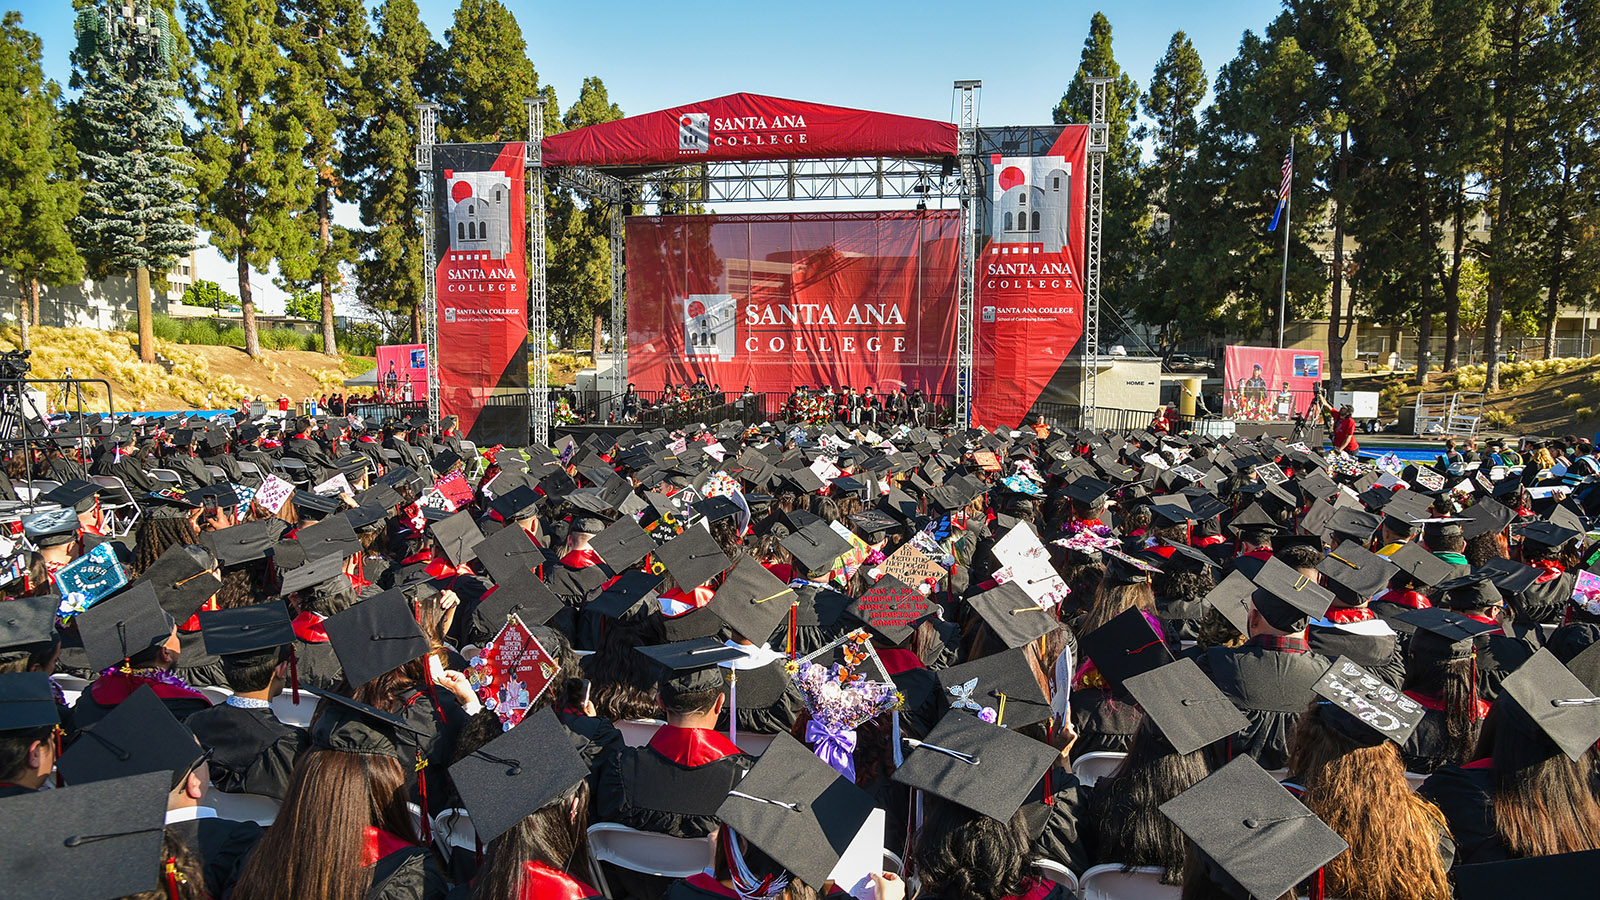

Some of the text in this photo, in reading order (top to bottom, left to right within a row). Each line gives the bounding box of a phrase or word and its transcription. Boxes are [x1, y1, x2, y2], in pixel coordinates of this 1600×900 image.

[714, 115, 807, 131] SANTA ANA
[714, 133, 807, 146] COLLEGE
[448, 268, 516, 280] SANTA ANA
[988, 263, 1072, 275] SANTA ANA
[448, 283, 517, 292] COLLEGE
[988, 280, 1073, 289] COLLEGE
[744, 303, 906, 326] SANTA ANA
[744, 336, 906, 352] COLLEGE
[682, 490, 695, 503] H
[867, 511, 885, 520] Class
[860, 595, 892, 603] PROPIO
[858, 603, 890, 611] NUNCA
[870, 611, 921, 619] IMPORTADO
[871, 619, 917, 627] COMPETIR
[1341, 662, 1418, 714] 2024
